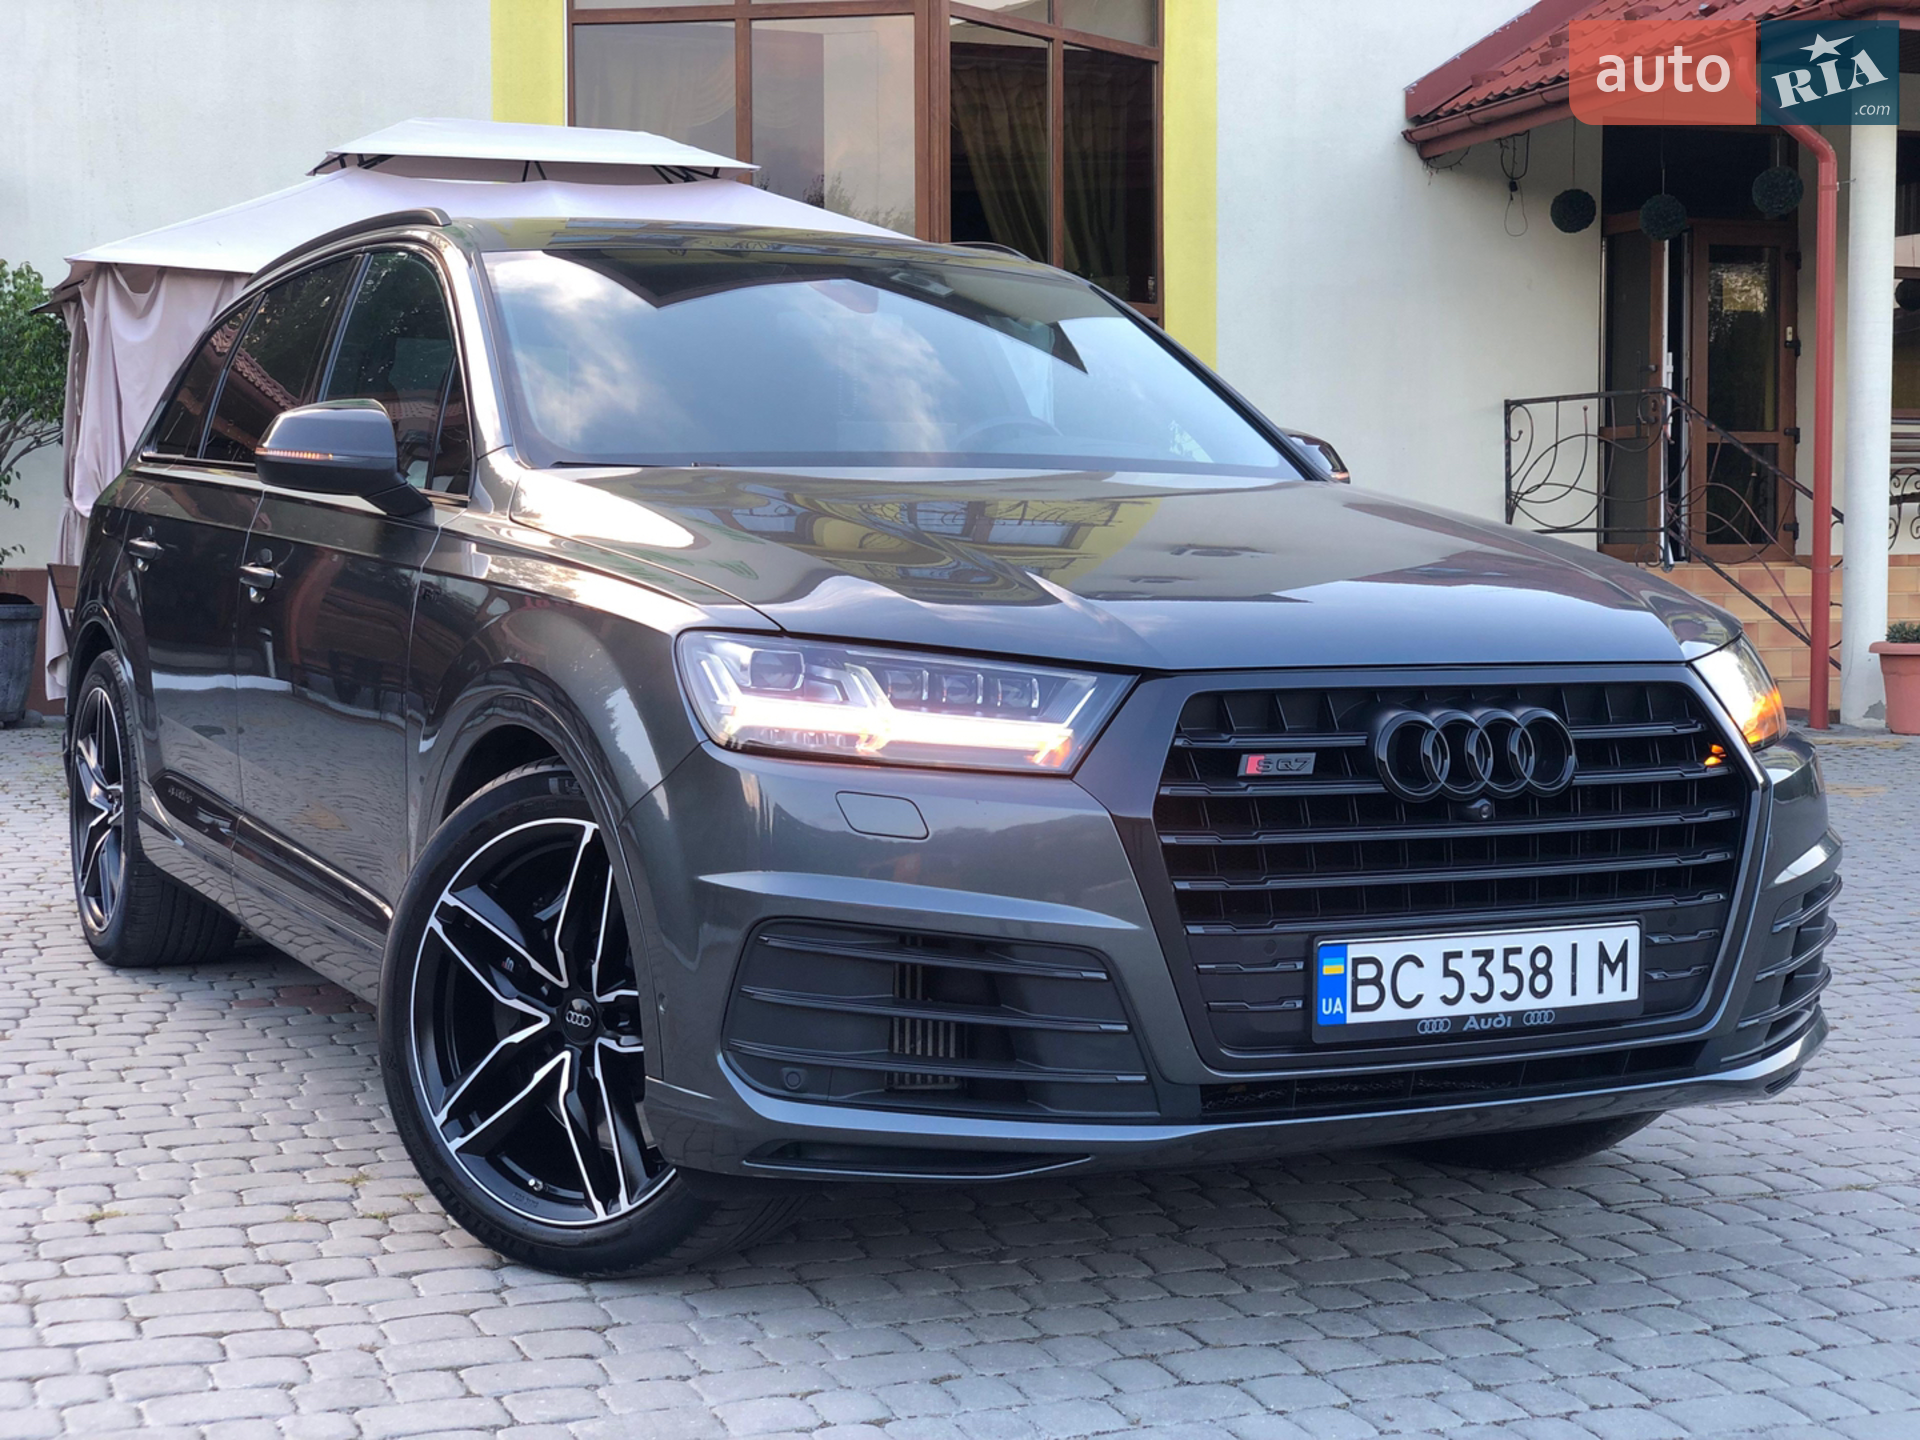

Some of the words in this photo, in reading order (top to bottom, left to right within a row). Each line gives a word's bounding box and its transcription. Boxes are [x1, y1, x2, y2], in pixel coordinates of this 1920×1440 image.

[1254, 757, 1311, 772] SQ7
[1350, 954, 1425, 1013] BC
[1439, 945, 1553, 1006] 5358
[1570, 938, 1629, 997] IM
[1321, 997, 1344, 1015] UA
[1462, 1013, 1512, 1031] Audi
